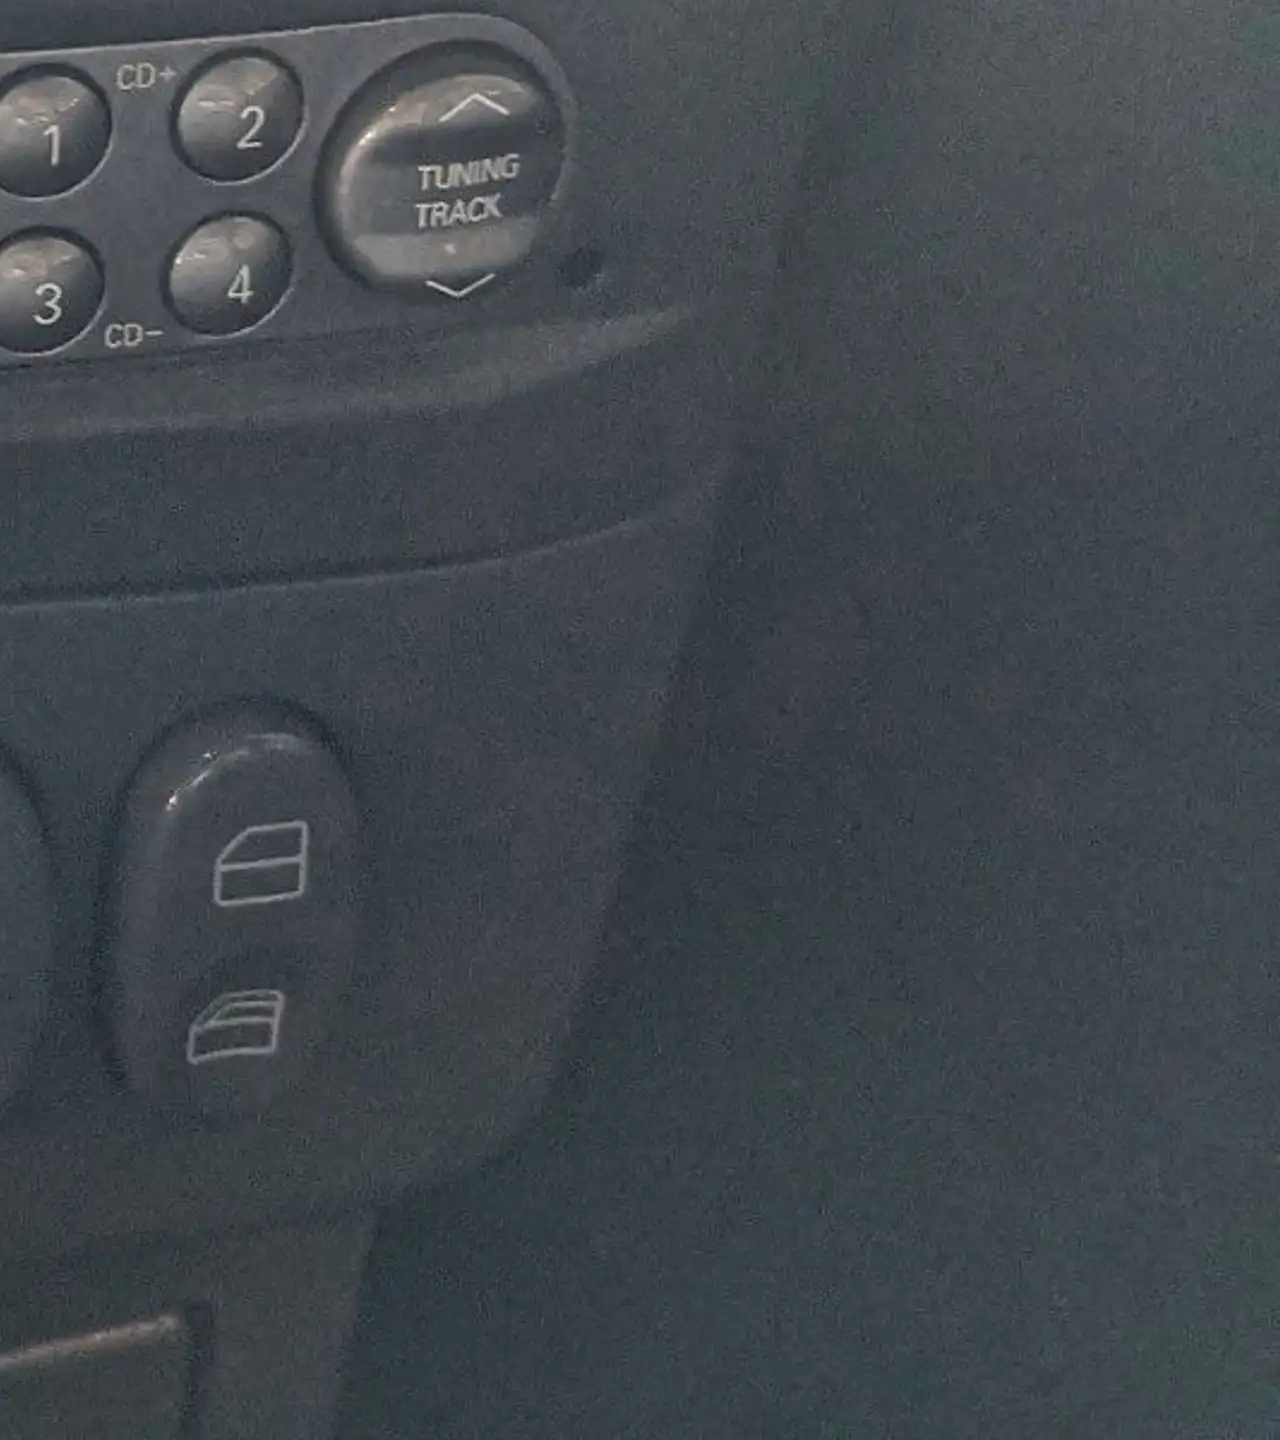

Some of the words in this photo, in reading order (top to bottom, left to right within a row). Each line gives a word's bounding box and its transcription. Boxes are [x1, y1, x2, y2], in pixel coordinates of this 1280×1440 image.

[42, 124, 61, 166] 1
[236, 105, 265, 149] 2
[417, 153, 521, 190] TUNING
[414, 192, 504, 228] TRACK
[31, 282, 62, 326] 3
[226, 264, 254, 304] 4
